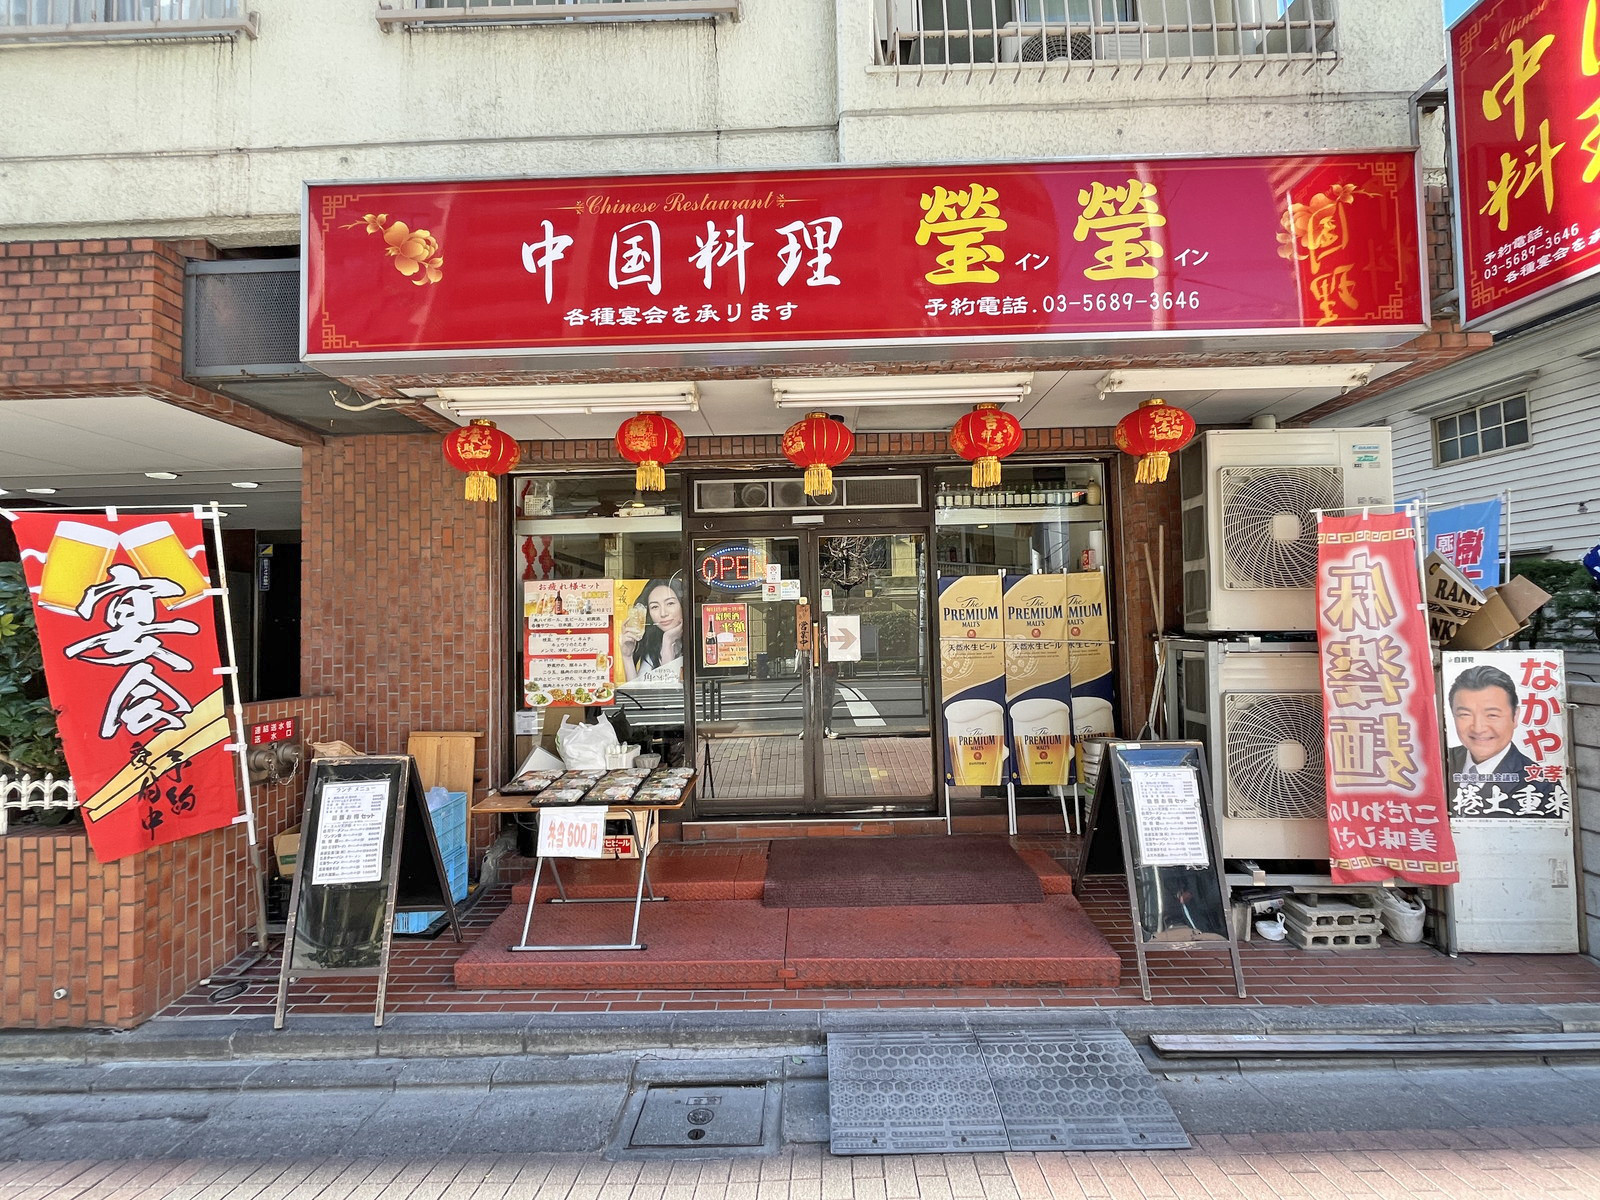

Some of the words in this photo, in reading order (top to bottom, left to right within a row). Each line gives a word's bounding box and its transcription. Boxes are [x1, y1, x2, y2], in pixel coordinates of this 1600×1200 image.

[585, 193, 658, 216] Chinese
[665, 190, 775, 213] Restaurant
[1484, 223, 1579, 279] 03-5689-3646
[521, 214, 843, 304] 中国料理
[564, 302, 798, 327] 各種宴会を承ります
[702, 555, 768, 581] OPEN
[538, 582, 600, 592] お疲れ様セット
[956, 597, 984, 608] The
[1021, 595, 1048, 606] The
[943, 606, 998, 621] PREMIUM
[1008, 605, 1063, 620] PREMIUM
[64, 564, 199, 739] 宴会
[948, 643, 997, 651] 天然水生ビール
[1012, 642, 1062, 651] 天然水生ビール
[1520, 657, 1562, 761] なかや
[958, 735, 996, 746] PREMIUM
[1024, 734, 1062, 745] PREMIUM
[1524, 765, 1564, 783] 文孝
